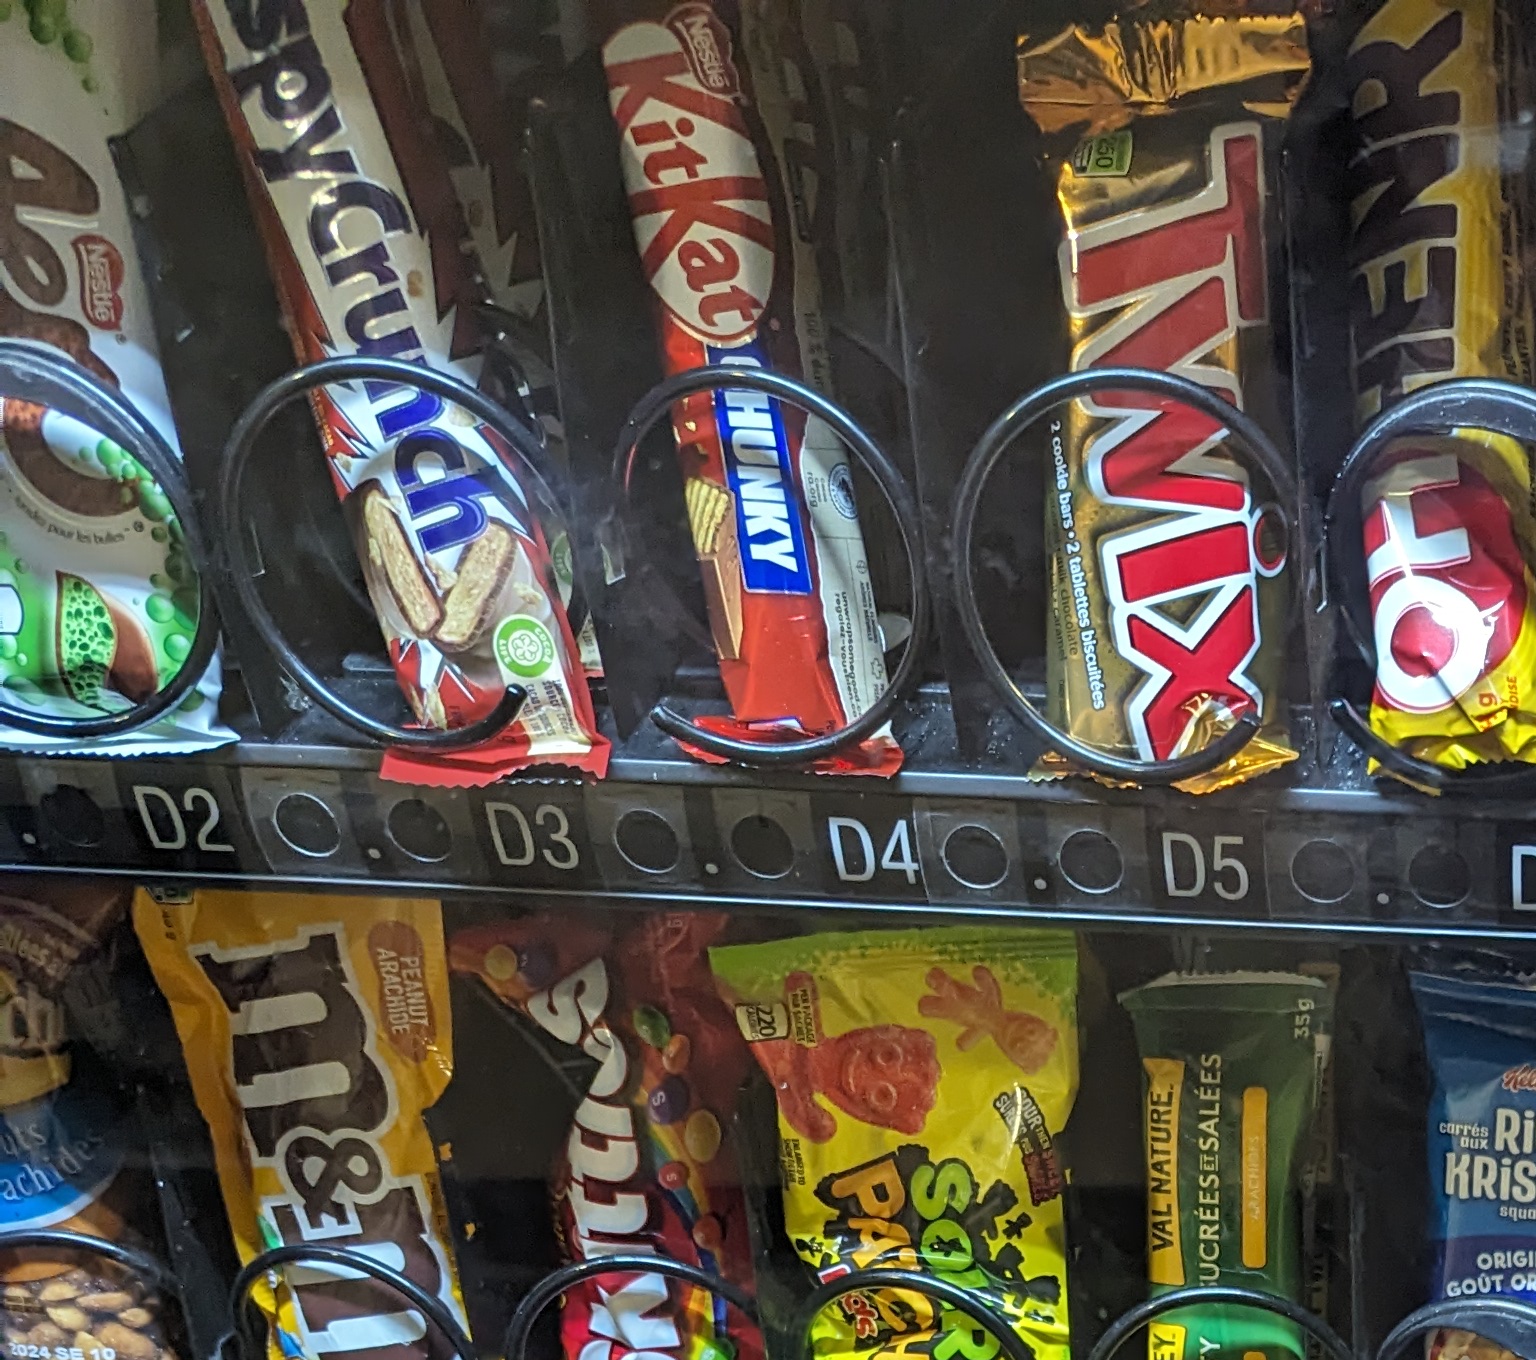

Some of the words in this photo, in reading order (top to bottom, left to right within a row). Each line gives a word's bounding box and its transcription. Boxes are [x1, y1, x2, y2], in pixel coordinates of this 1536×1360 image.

[1052, 438, 1068, 491] cookie
[1059, 492, 1074, 530] bars
[1069, 557, 1091, 628] tablettes
[499, 639, 513, 665] LIFE
[535, 627, 554, 664] COCOA
[1060, 589, 1078, 656] chocolate
[1081, 629, 1106, 711] biscuitées
[135, 786, 234, 853] D2
[487, 804, 580, 870] D3
[830, 817, 919, 885] D4
[1162, 833, 1248, 899] D5
[376, 947, 411, 1034] ARACHIDE
[399, 955, 429, 1027] PEANUT
[756, 1004, 776, 1038] 220
[1194, 1053, 1222, 1152] SALÉES
[1440, 1121, 1489, 1137] carrés
[1460, 1136, 1489, 1150] aux
[1152, 1202, 1174, 1252] VAL
[1446, 1272, 1504, 1299] GOÛT
[54, 1347, 85, 1360] SE
[90, 1347, 116, 1360] 10
